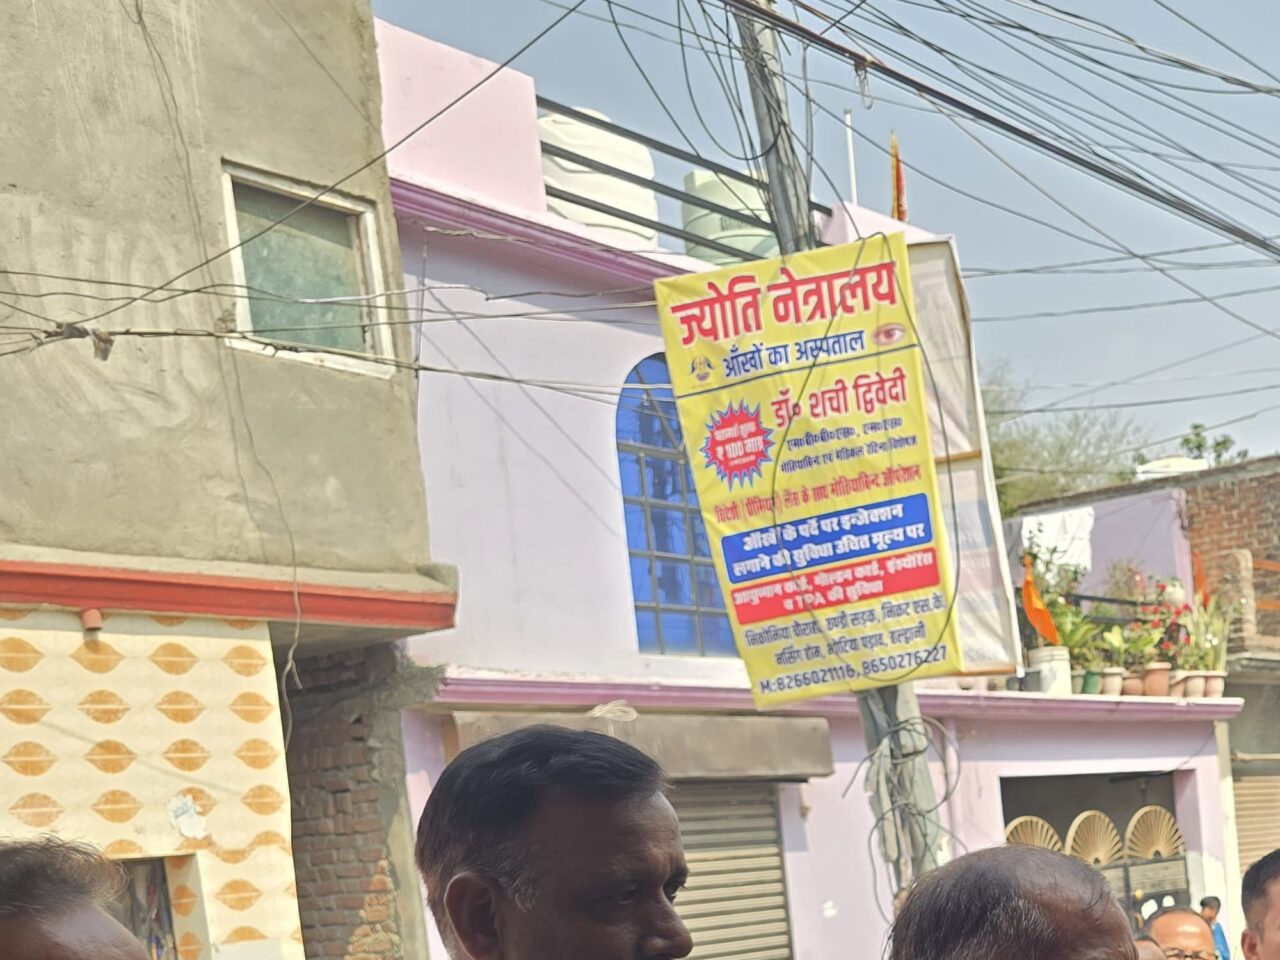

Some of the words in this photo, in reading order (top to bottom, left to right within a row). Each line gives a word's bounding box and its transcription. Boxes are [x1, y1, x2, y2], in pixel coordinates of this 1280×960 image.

[671, 275, 761, 345] ज्योति
[767, 262, 896, 324] नेत्रालय
[723, 343, 765, 377] आँखों
[767, 344, 788, 364] का
[795, 330, 864, 359] अस्पताल
[809, 379, 848, 417] शची
[853, 367, 906, 413] द्विवेदी
[800, 487, 810, 503] के
[781, 524, 797, 541] के
[820, 516, 839, 532] पर
[732, 556, 770, 575] लगाने
[770, 549, 791, 567] की
[792, 541, 833, 565] सुविधा
[833, 532, 870, 554] उचित
[870, 526, 904, 550] मूल्य
[905, 522, 925, 539] पर
[794, 591, 826, 609] TPA
[826, 586, 843, 602] की
[845, 578, 884, 601] सुविधा
[881, 600, 911, 619] निकट
[863, 647, 946, 674] 8650276227
